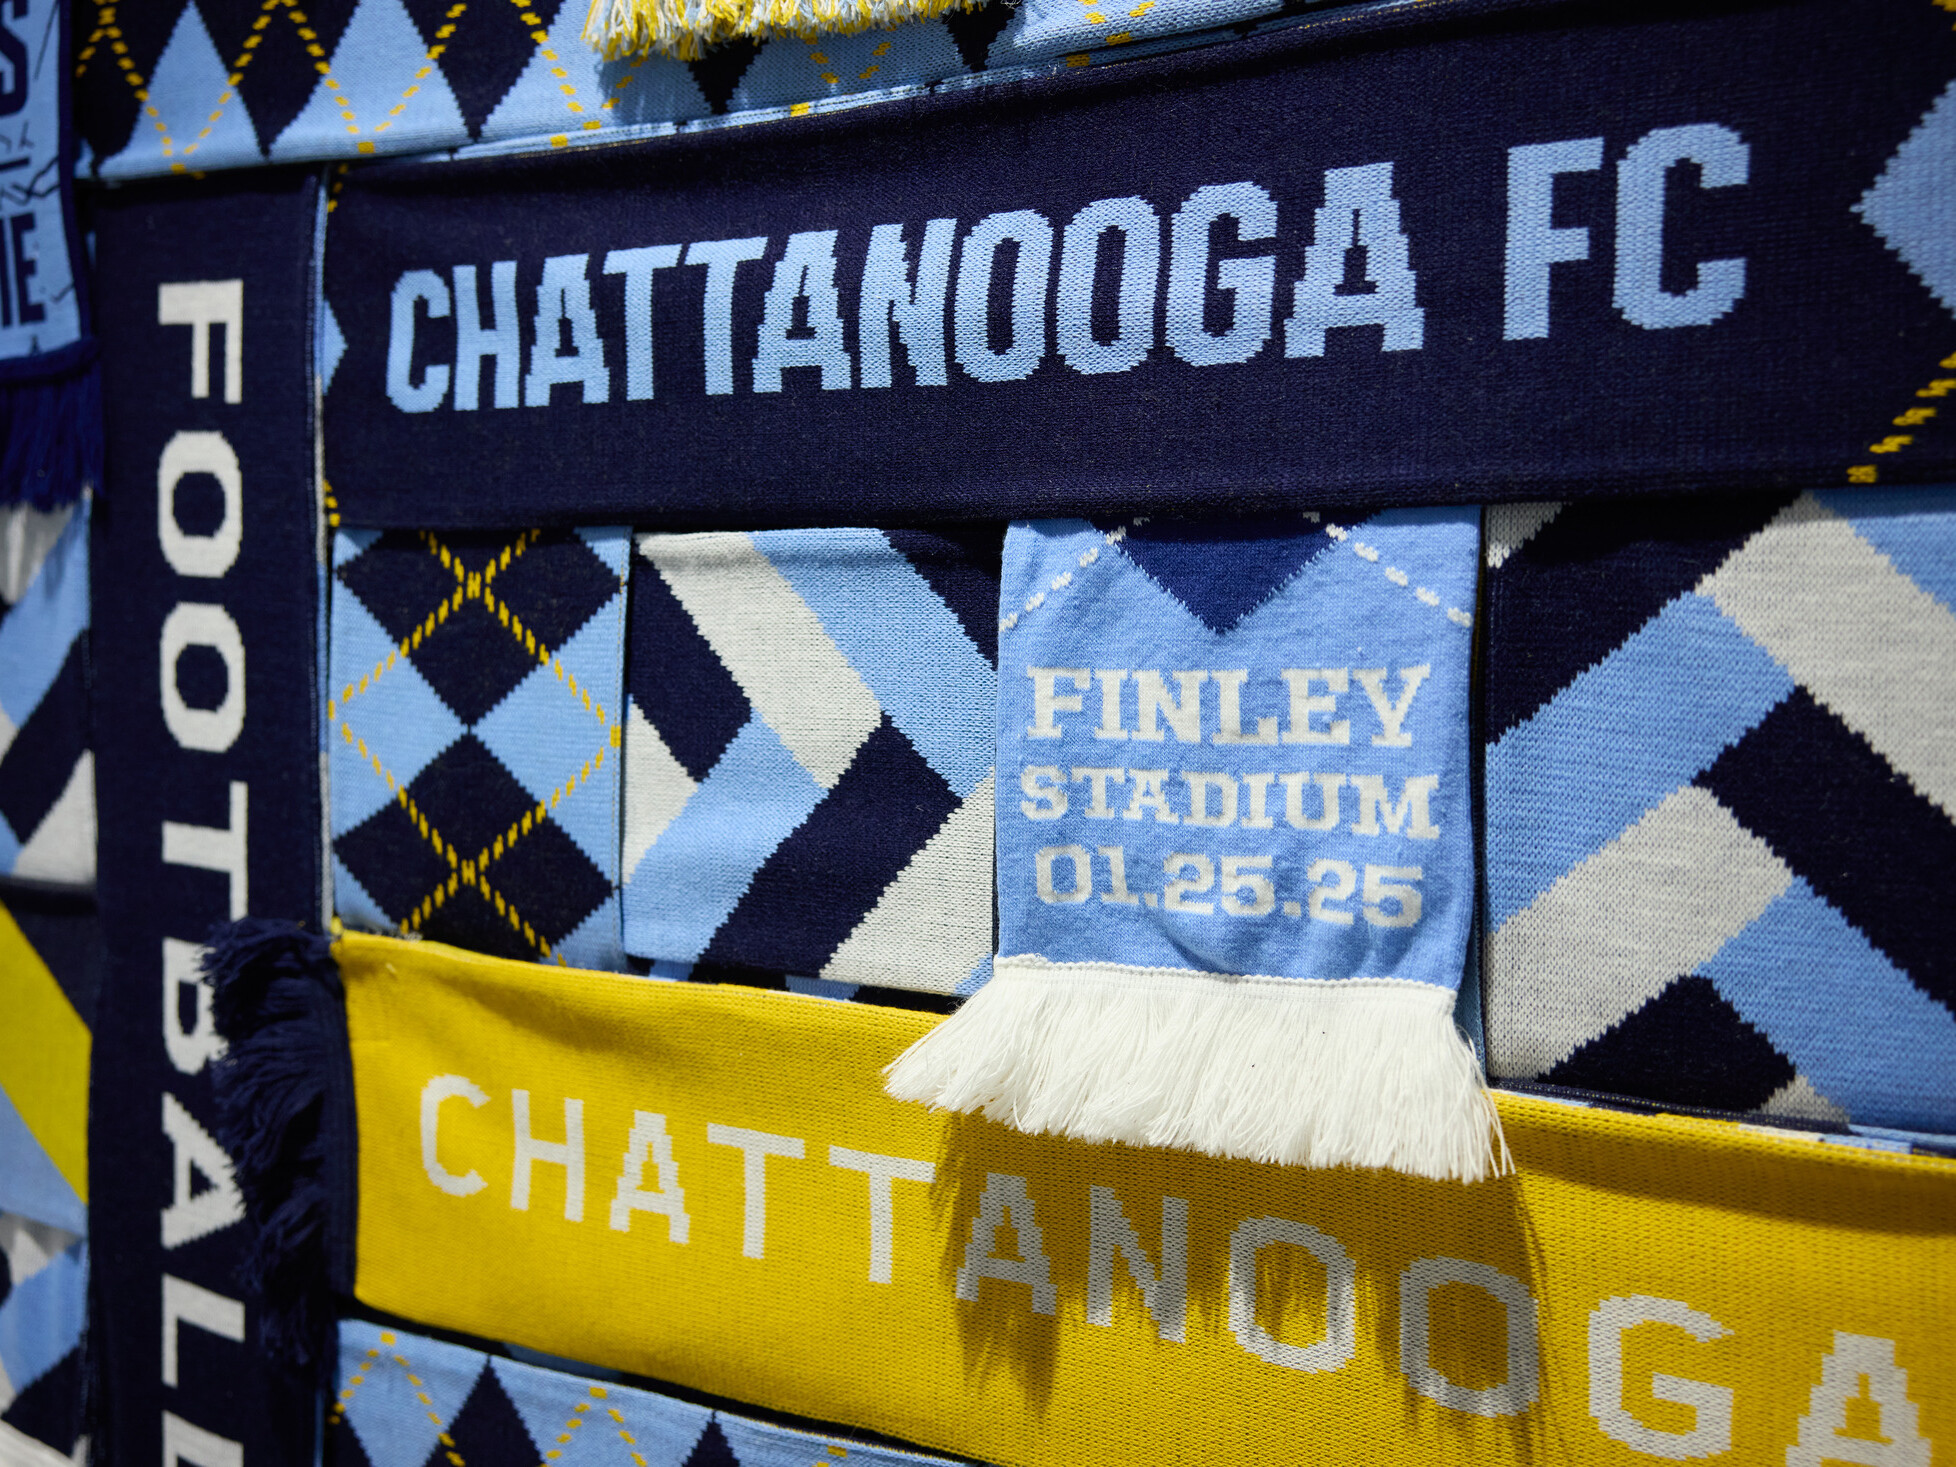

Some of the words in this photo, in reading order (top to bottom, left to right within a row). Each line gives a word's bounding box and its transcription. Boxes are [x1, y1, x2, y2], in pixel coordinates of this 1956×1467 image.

[386, 161, 1425, 414] CHATTANOOGA
[1502, 123, 1751, 341] FC
[1026, 662, 1432, 748] FINLEY
[1020, 764, 1440, 840] STADIUM
[1034, 843, 1423, 928] 01.25.25
[420, 1073, 1933, 1467] CHATTANOOGA
